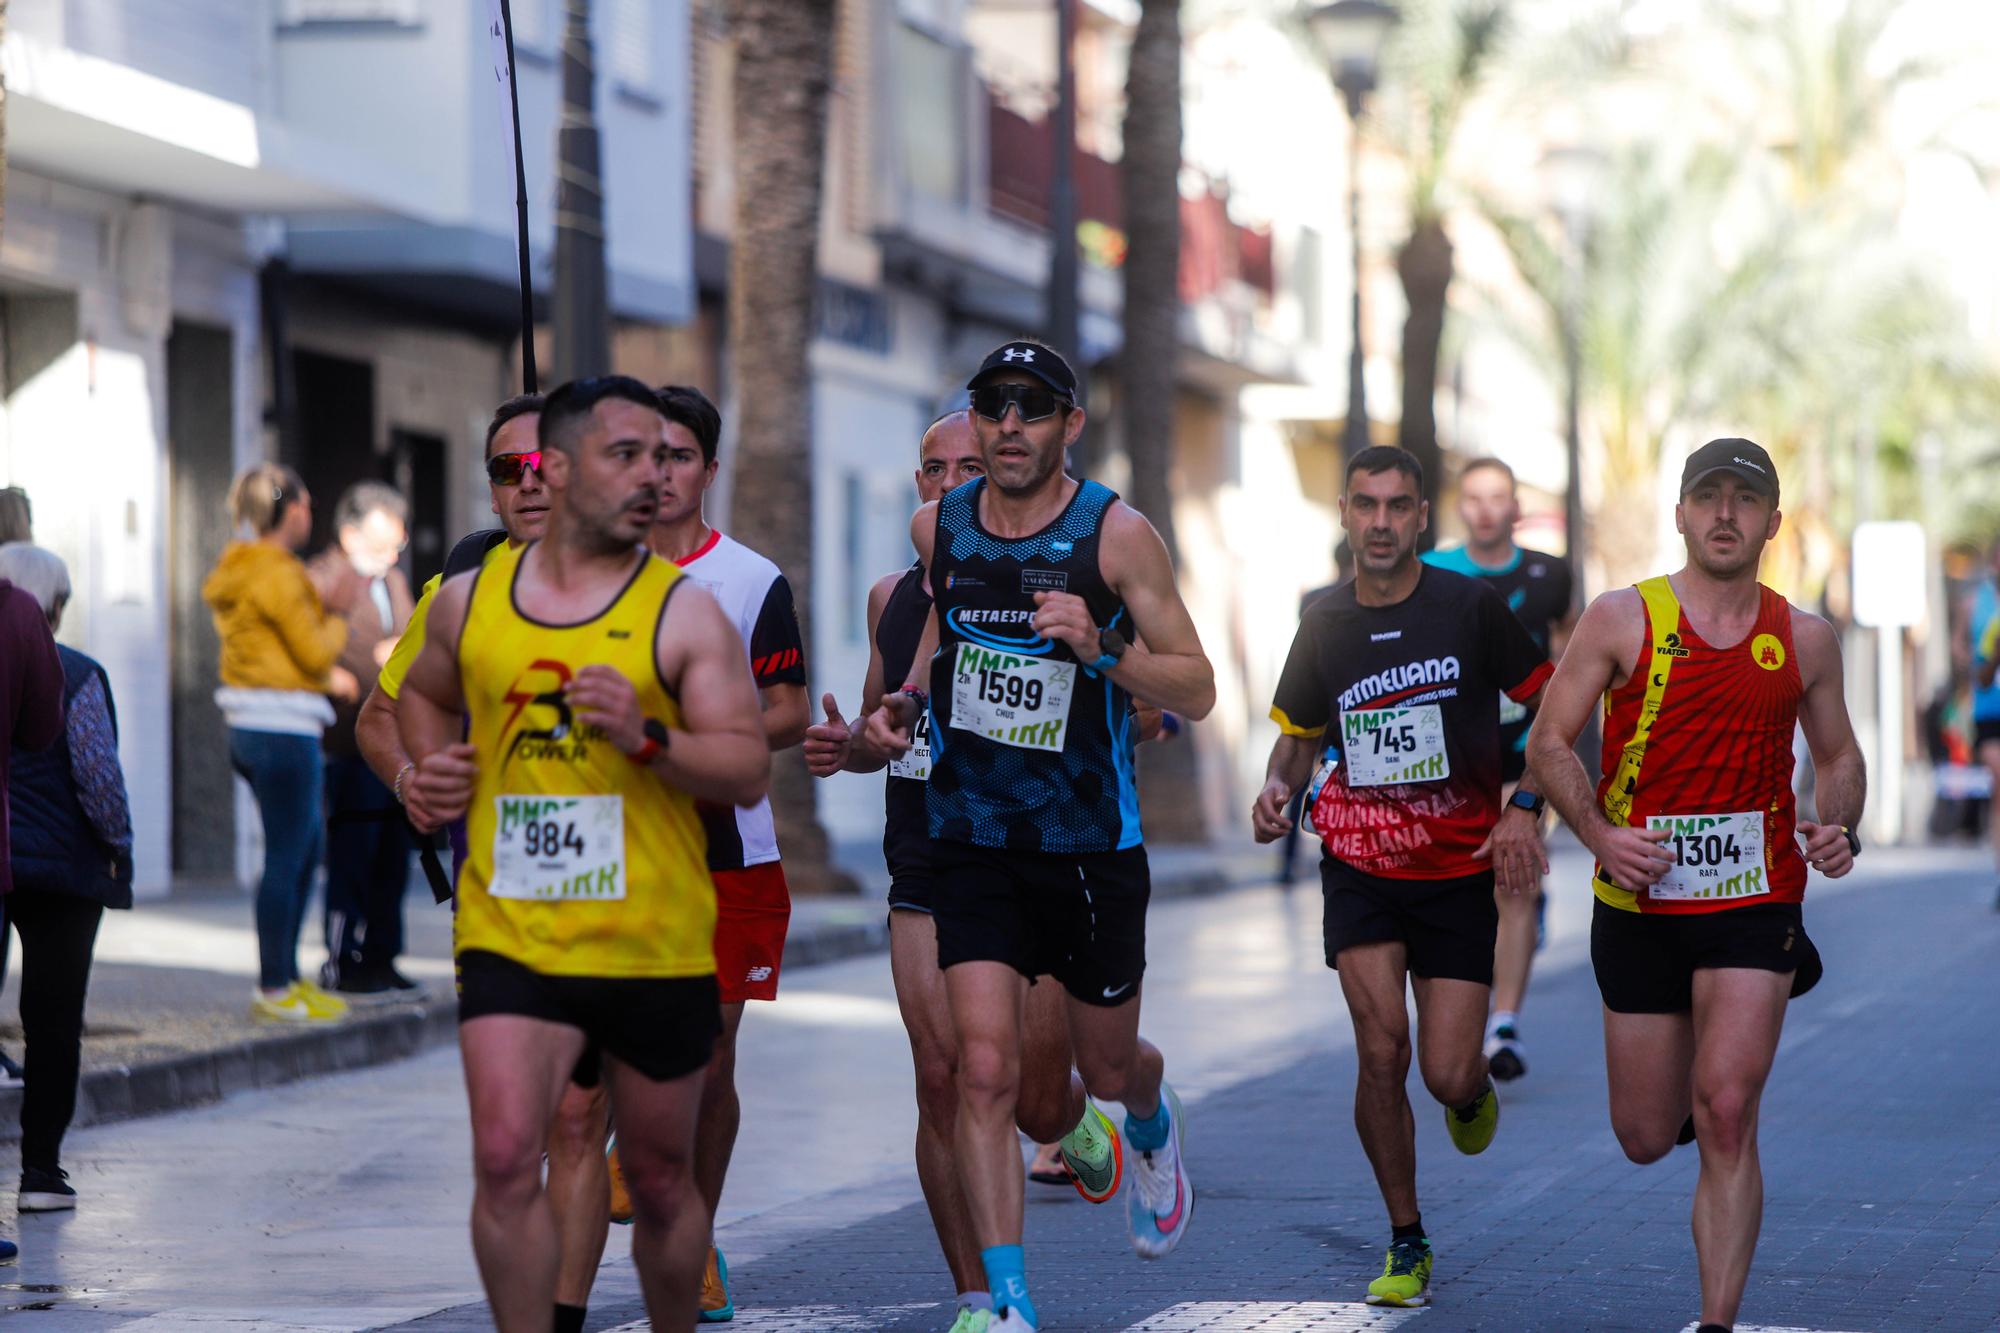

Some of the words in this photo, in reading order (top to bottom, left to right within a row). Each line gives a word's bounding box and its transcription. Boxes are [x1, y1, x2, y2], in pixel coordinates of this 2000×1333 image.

[1657, 647, 1689, 657] VIATOR
[978, 669, 1044, 711] 1599
[995, 708, 1015, 719] CHUS
[1367, 725, 1416, 754] 745
[524, 821, 585, 857] 984
[1672, 833, 1741, 867] 1304
[1699, 868, 1719, 878] RAFA
